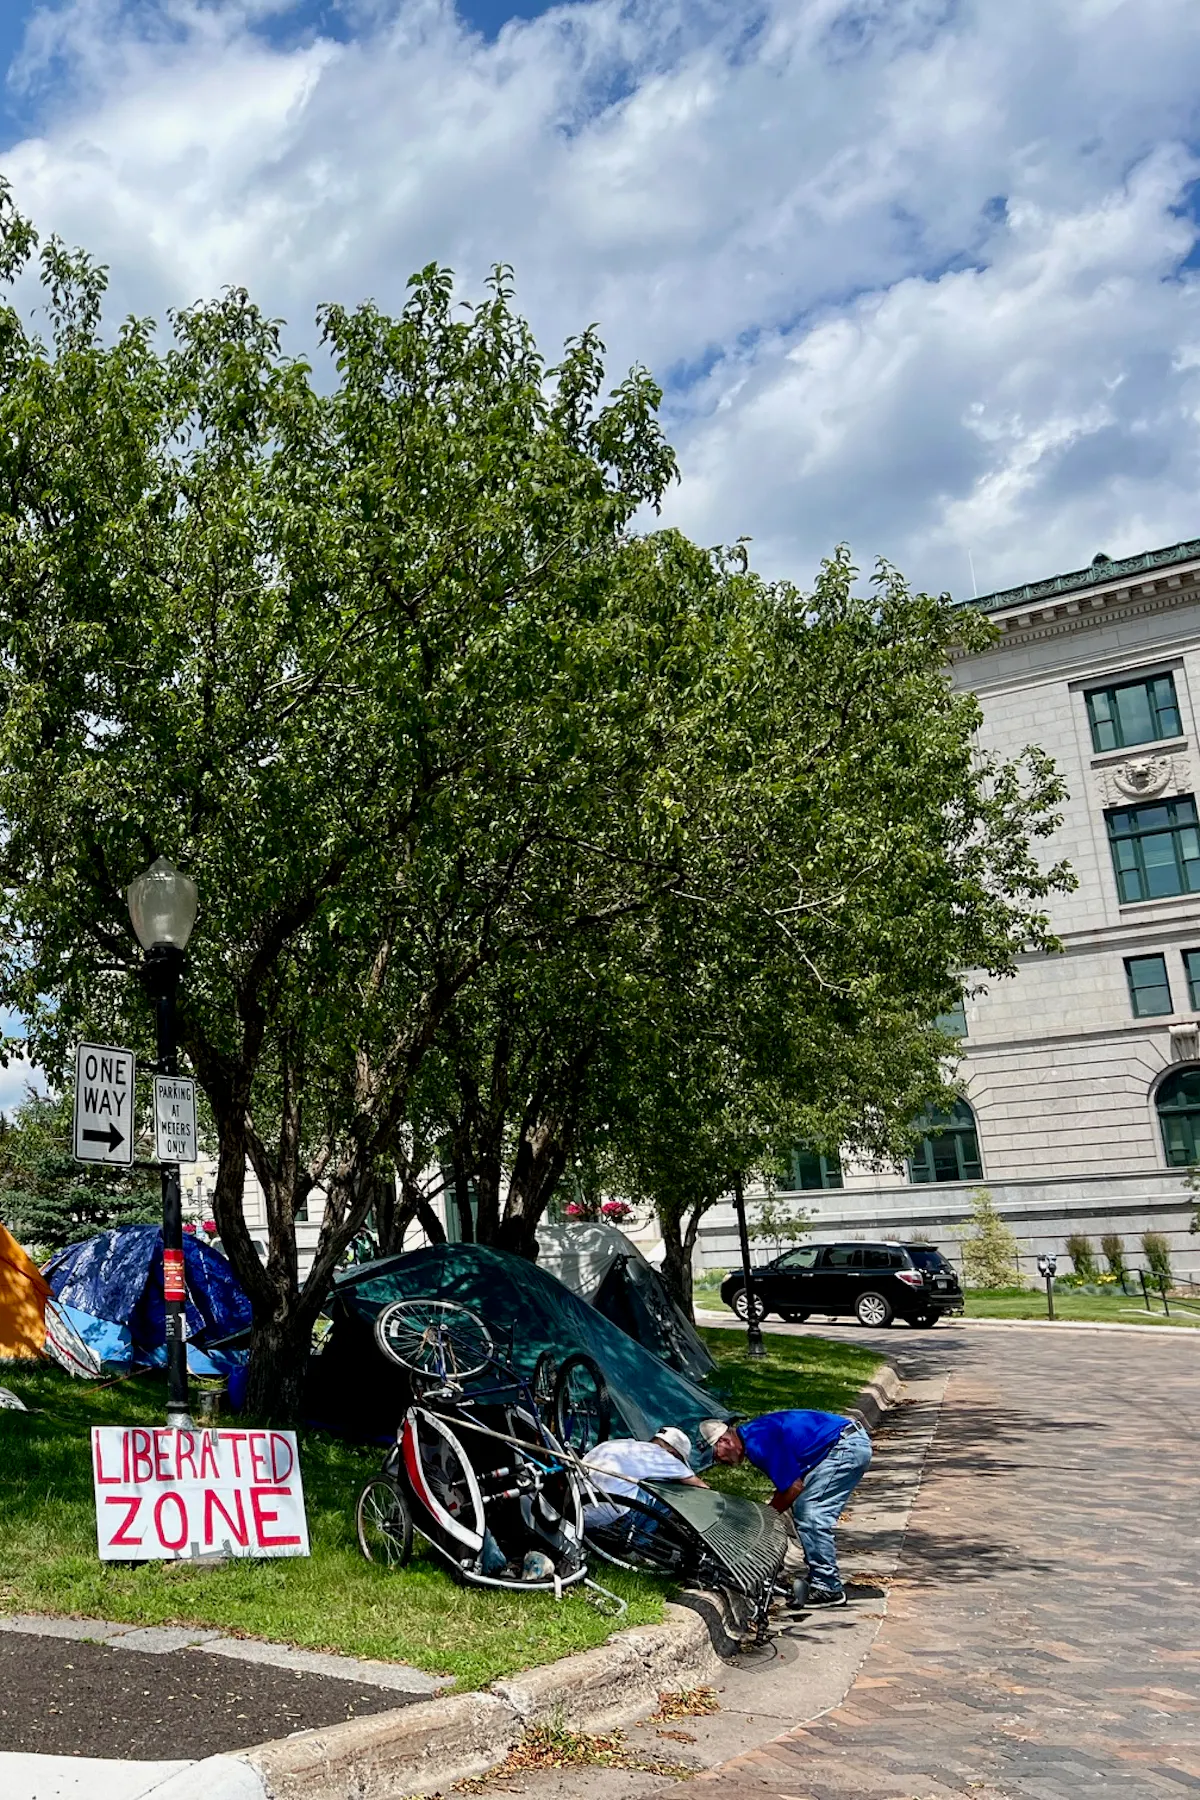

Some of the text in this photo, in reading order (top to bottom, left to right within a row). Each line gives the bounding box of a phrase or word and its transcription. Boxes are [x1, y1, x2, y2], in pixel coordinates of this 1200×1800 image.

[86, 1055, 126, 1085] ONE
[84, 1087, 126, 1116] WAY
[159, 1086, 191, 1101] PARKING
[171, 1104, 180, 1117] AT
[162, 1121, 191, 1136] METERS
[167, 1140, 186, 1154] ONLY
[95, 1429, 294, 1485] LIBERATED
[104, 1486, 301, 1550] ZONE
